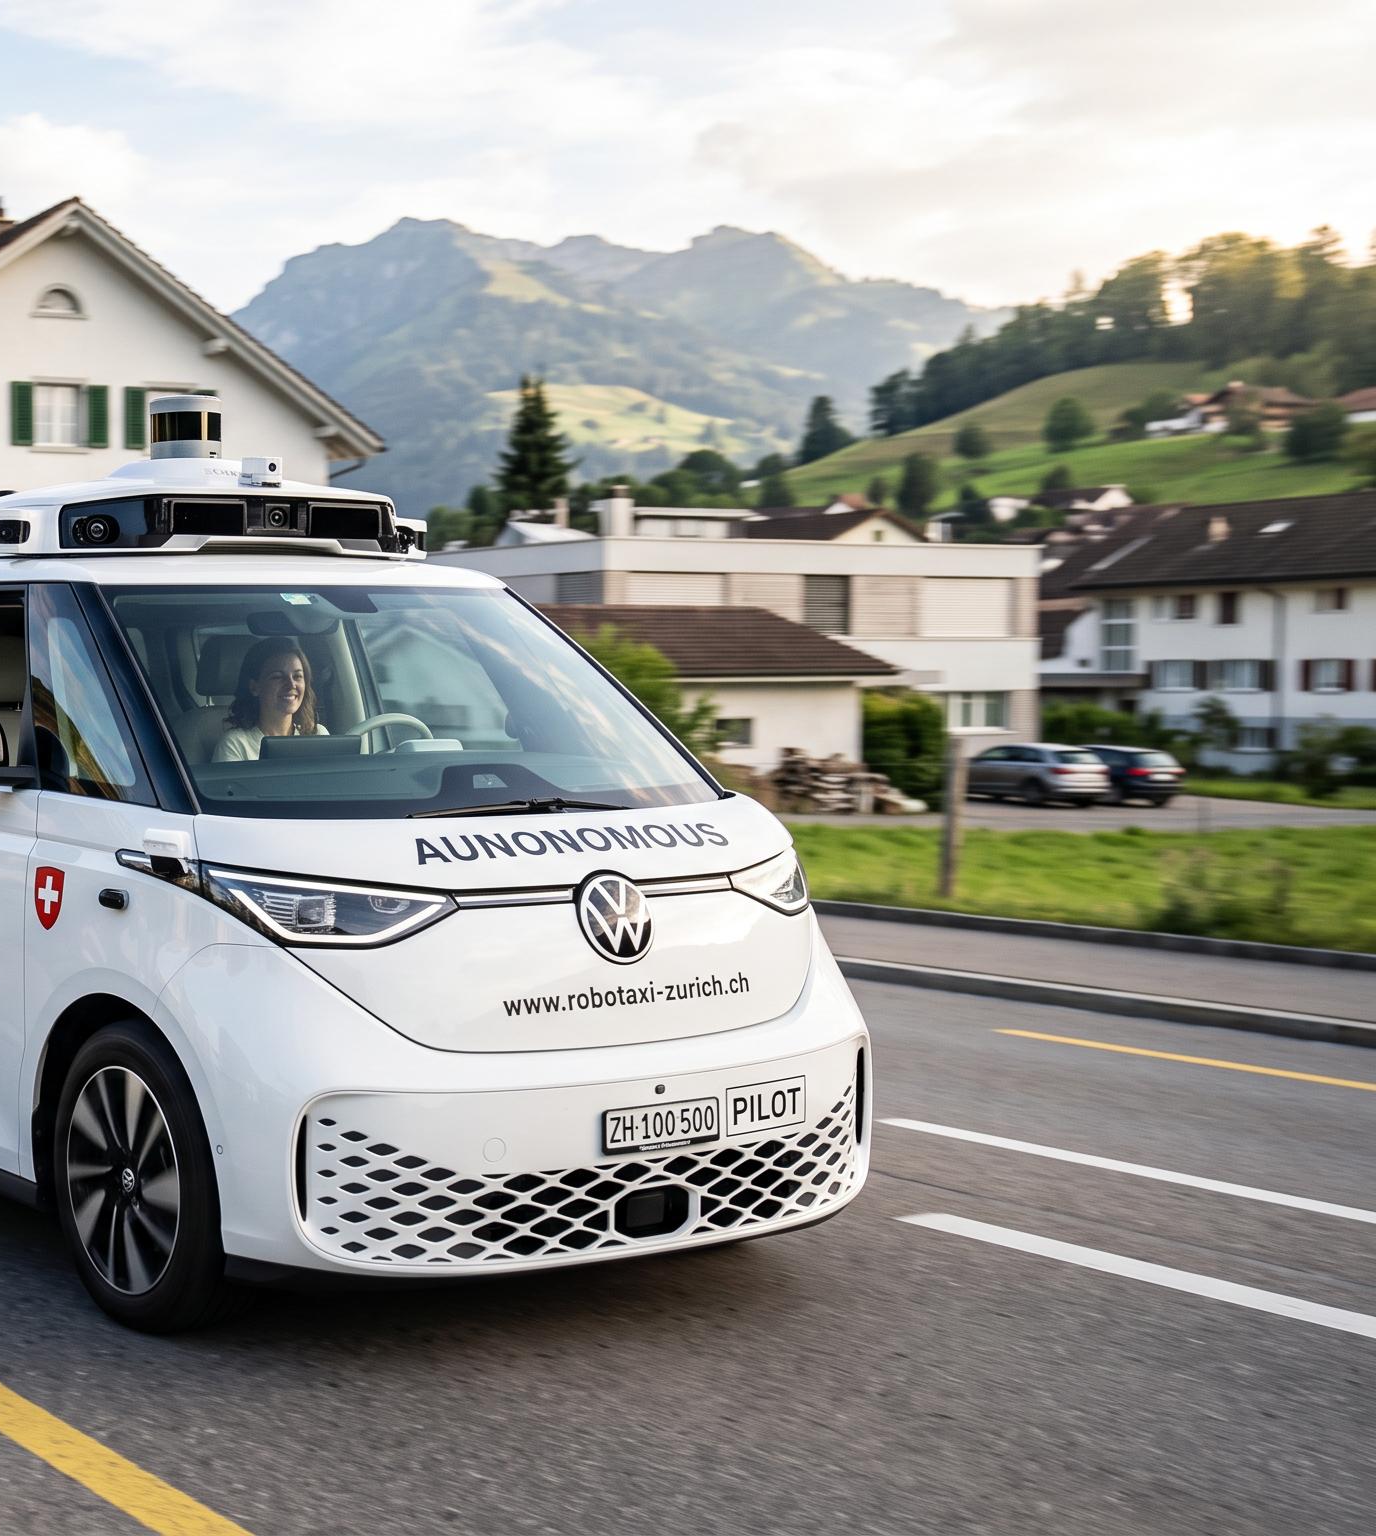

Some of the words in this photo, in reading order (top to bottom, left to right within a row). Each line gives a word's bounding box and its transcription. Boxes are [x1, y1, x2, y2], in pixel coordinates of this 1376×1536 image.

[414, 822, 729, 866] AUNONOMOUS
[503, 972, 750, 1017] www.robotaxi-zurich.ch
[733, 1086, 801, 1126] PILOT
